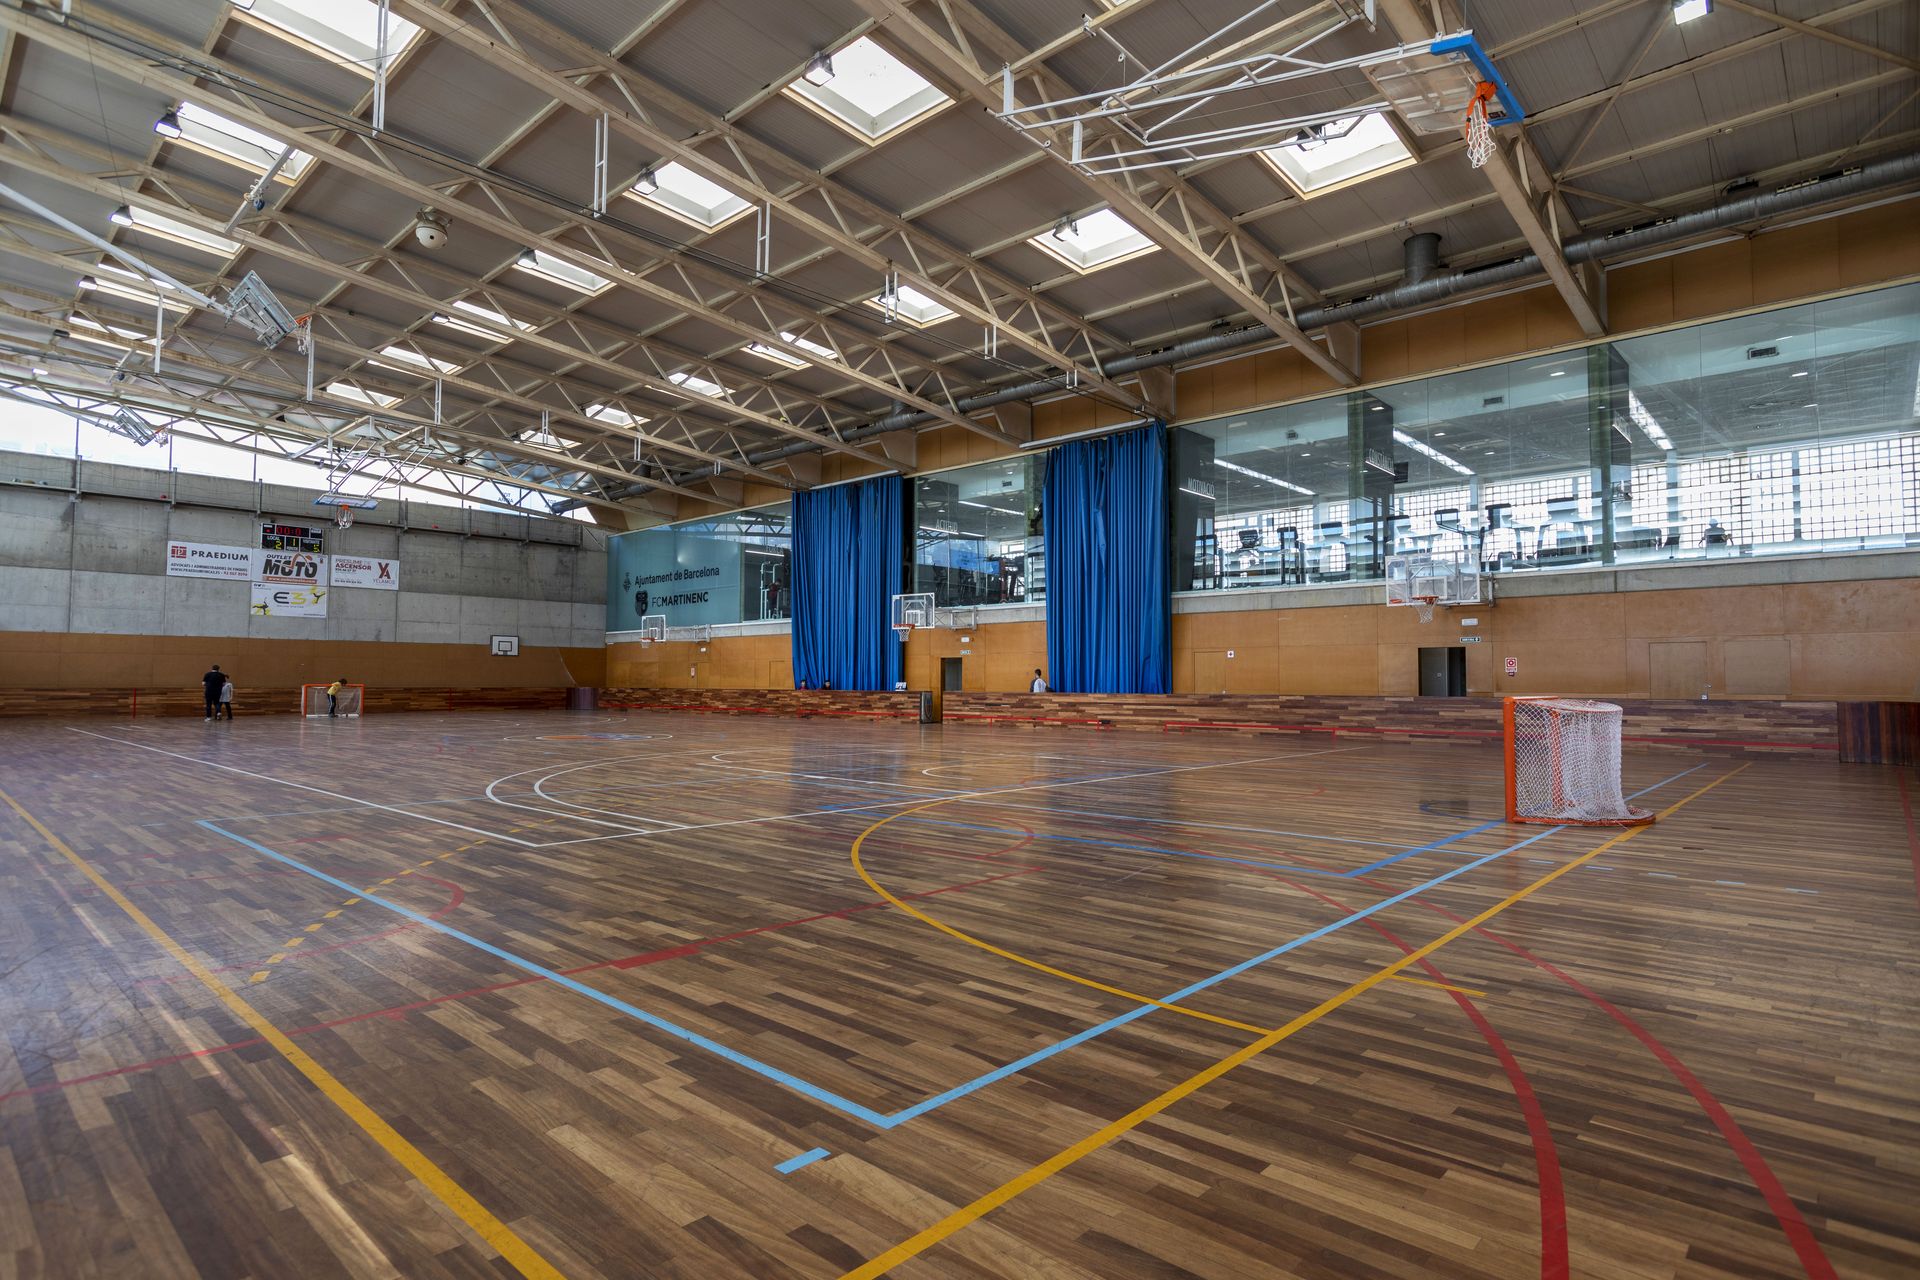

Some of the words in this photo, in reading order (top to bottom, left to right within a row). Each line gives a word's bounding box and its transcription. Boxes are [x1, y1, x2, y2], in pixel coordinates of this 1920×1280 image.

[191, 549, 249, 561] PRAEDIUM
[262, 558, 318, 578] MOTO
[335, 562, 372, 571] ASCENSOR
[634, 571, 673, 588] Ajuntament
[673, 569, 683, 581] de
[683, 566, 720, 580] Barcelona
